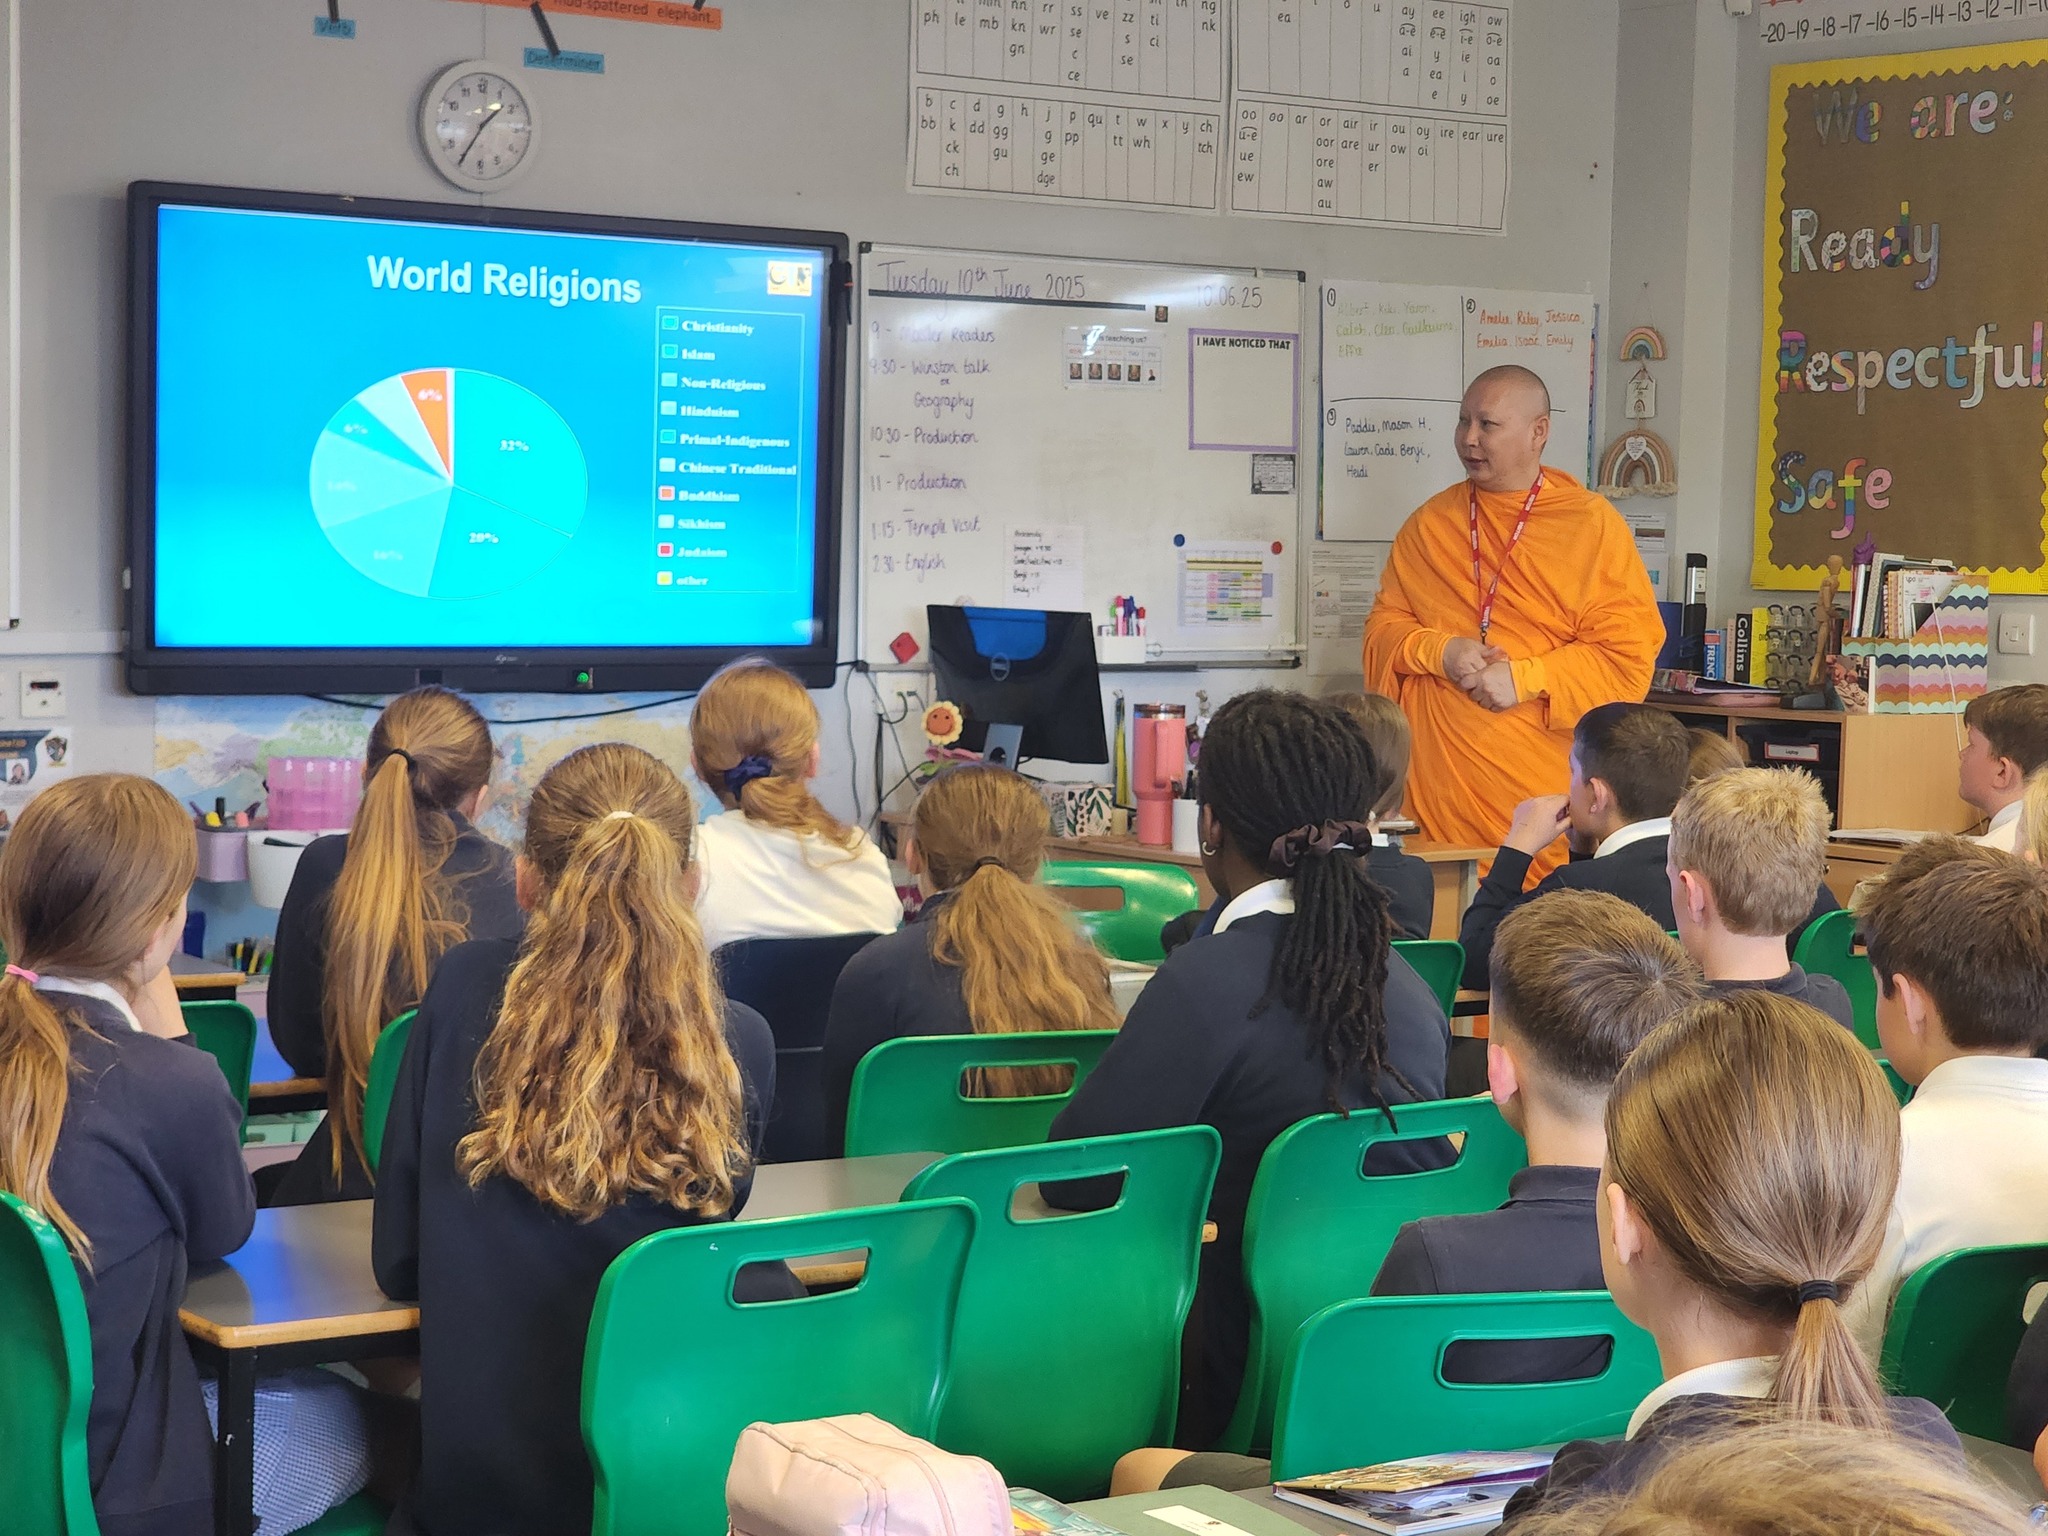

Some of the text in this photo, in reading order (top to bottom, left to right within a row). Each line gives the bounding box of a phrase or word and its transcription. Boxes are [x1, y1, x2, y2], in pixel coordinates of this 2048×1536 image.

[1071, 6, 1082, 17] ss
[1096, 9, 1109, 20] ve
[1402, 7, 1415, 19] ay
[1433, 10, 1445, 20] ee
[1459, 10, 1475, 25] igh
[923, 10, 939, 26] ph
[955, 12, 966, 26] le
[980, 17, 999, 30] mb
[1122, 13, 1134, 23] zz
[1278, 13, 1291, 23] ea
[1487, 16, 1502, 26] ow
[1761, 22, 1786, 43] -20
[1788, 18, 1809, 40] -19
[1814, 16, 1836, 37] -18
[1840, 14, 1862, 34] -17
[1866, 10, 1890, 32] -16
[1894, 7, 1917, 29] -15
[1921, 3, 1944, 25] -14
[1948, 1, 1971, 22] -13
[1976, 0, 1999, 19] -12
[2004, 0, 2022, 16] -11
[1011, 18, 1026, 33] kn
[1040, 24, 1056, 35] wr
[1202, 19, 1216, 32] nk
[1070, 28, 1082, 38] se
[1150, 35, 1160, 47] ci
[1010, 43, 1025, 57] gn
[1402, 46, 1412, 57] ai
[1121, 54, 1133, 66] se
[1461, 53, 1470, 63] ie
[1487, 55, 1500, 66] oa
[1068, 69, 1080, 82] ce
[1430, 69, 1442, 80] ea
[1487, 95, 1499, 106] oe
[1088, 113, 1103, 126] qu
[1242, 110, 1257, 120] oo
[1269, 112, 1284, 123] oo
[1295, 113, 1307, 124] ar
[1812, 88, 2014, 145] We are:
[921, 117, 936, 130] bb
[969, 121, 985, 134] dd
[1200, 120, 1213, 133] ch
[1320, 117, 1331, 127] or
[1343, 118, 1358, 130] air
[1369, 120, 1378, 131] ir
[993, 126, 1008, 140] gg
[1392, 124, 1405, 134] ou
[1416, 126, 1429, 140] oy
[1440, 127, 1454, 139] ire
[1065, 132, 1079, 146] pp
[1114, 135, 1123, 147] tt
[1133, 136, 1150, 149] wh
[1462, 131, 1480, 142] ear
[1486, 132, 1504, 143] ure
[946, 141, 959, 154] ck
[1316, 138, 1334, 148] oor
[1341, 140, 1359, 150] are
[1368, 141, 1379, 152] ur
[1390, 144, 1406, 154] ow
[993, 147, 1008, 160] gu
[1418, 145, 1428, 156] oi
[1041, 151, 1055, 164] ge
[1240, 152, 1254, 162] ue
[1316, 158, 1334, 169] ore
[1368, 162, 1378, 172] er
[945, 163, 959, 177] ch
[1037, 172, 1055, 187] dge
[1237, 172, 1254, 183] ew
[1317, 178, 1332, 188] aw
[1317, 198, 1332, 209] au
[1790, 200, 1940, 290] Ready
[367, 255, 642, 307] World Religions
[993, 269, 1033, 299] June
[1045, 274, 1085, 300] 2025
[681, 319, 755, 336] Christianity
[1203, 337, 1226, 348] HAVE
[1228, 338, 1266, 349] NOTICED
[1268, 340, 1291, 350] THAT
[681, 348, 716, 361] Islam
[1779, 321, 2047, 416] Respectful
[680, 376, 767, 392] Non-Religious
[680, 404, 740, 418] Hinduism
[914, 391, 975, 420] Geography
[1382, 419, 1413, 432] Mason
[679, 433, 791, 449] Primal-Indigenous
[914, 427, 979, 444] Production
[678, 461, 797, 476] Chinese Traditional
[897, 472, 967, 491] Production
[678, 490, 741, 503] Buddhism
[1778, 450, 1894, 539] Safe
[677, 518, 727, 530] Sikhism
[676, 546, 728, 558] Judaism
[675, 575, 709, 586] other
[1736, 617, 1748, 672] Collins
